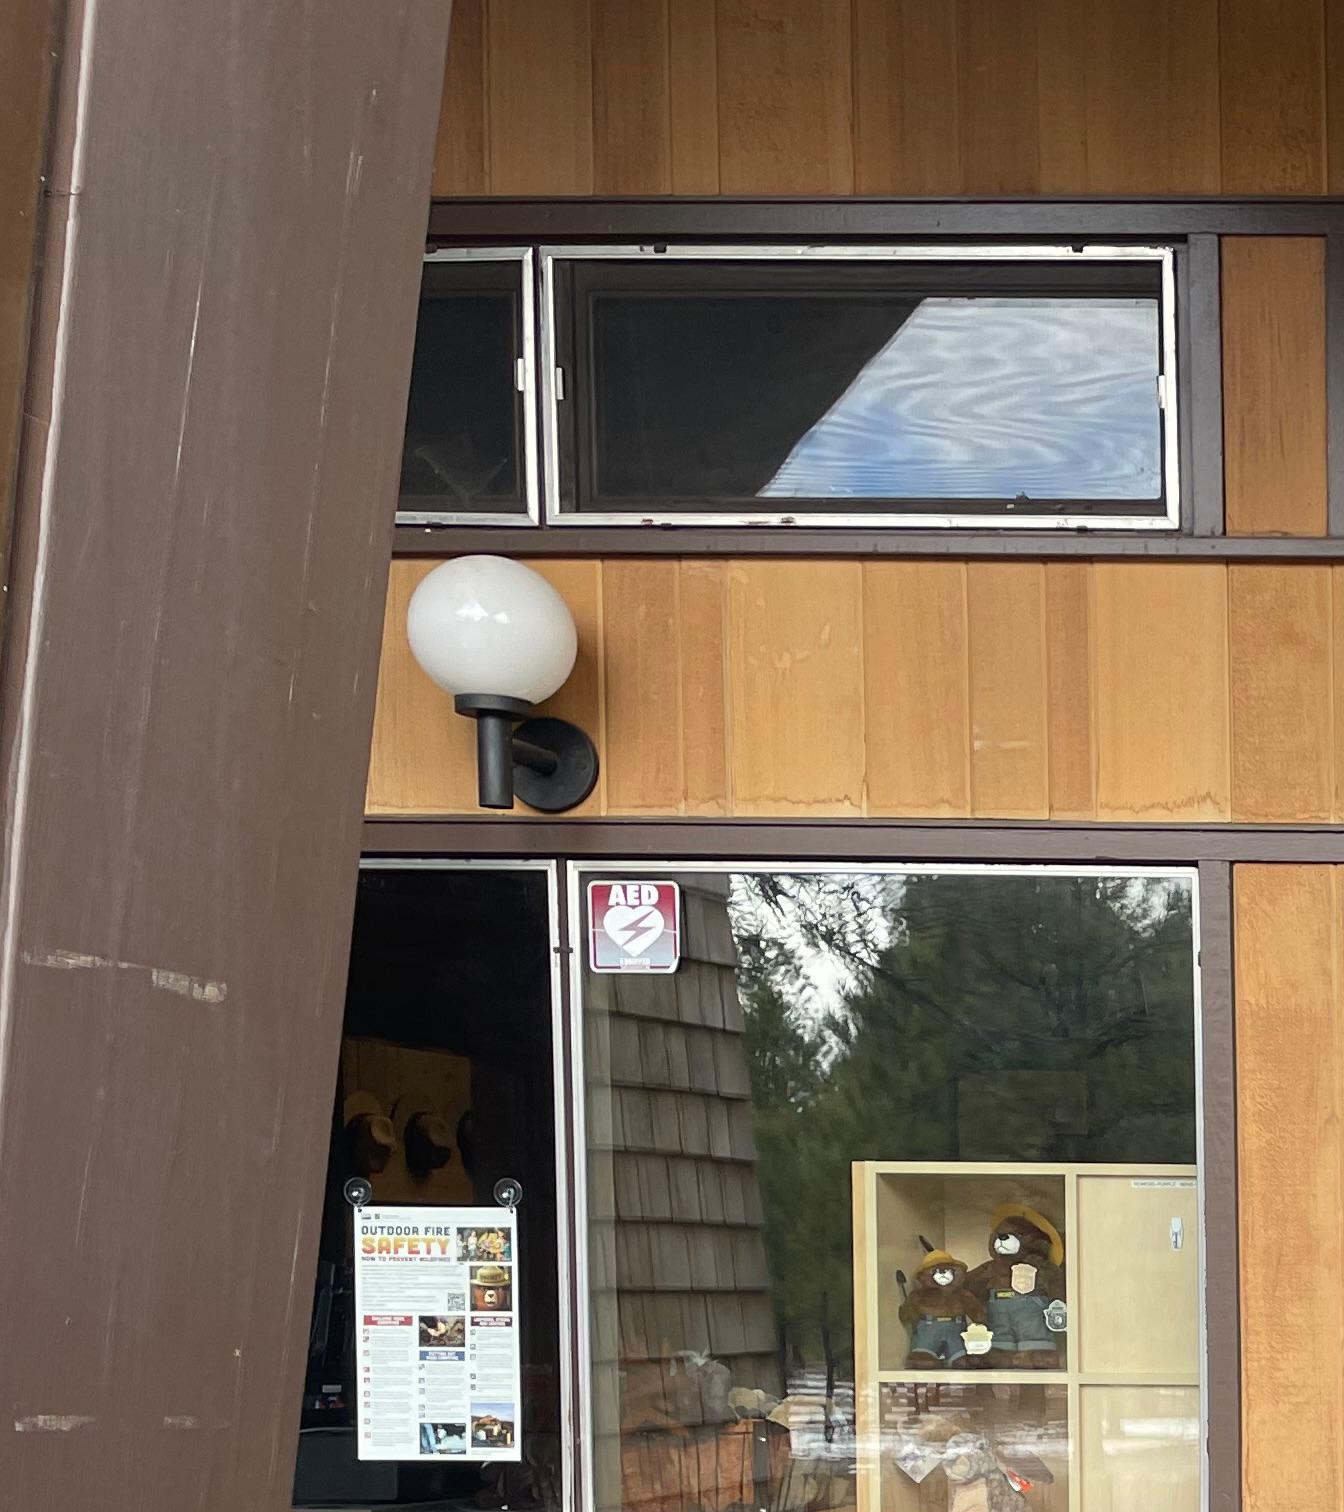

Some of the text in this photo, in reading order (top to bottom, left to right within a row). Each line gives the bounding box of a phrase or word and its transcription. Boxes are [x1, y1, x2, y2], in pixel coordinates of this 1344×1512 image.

[608, 884, 659, 906] AED
[361, 1225, 451, 1236] OUTDOOR FIRE
[361, 1236, 450, 1255] SAFETY
